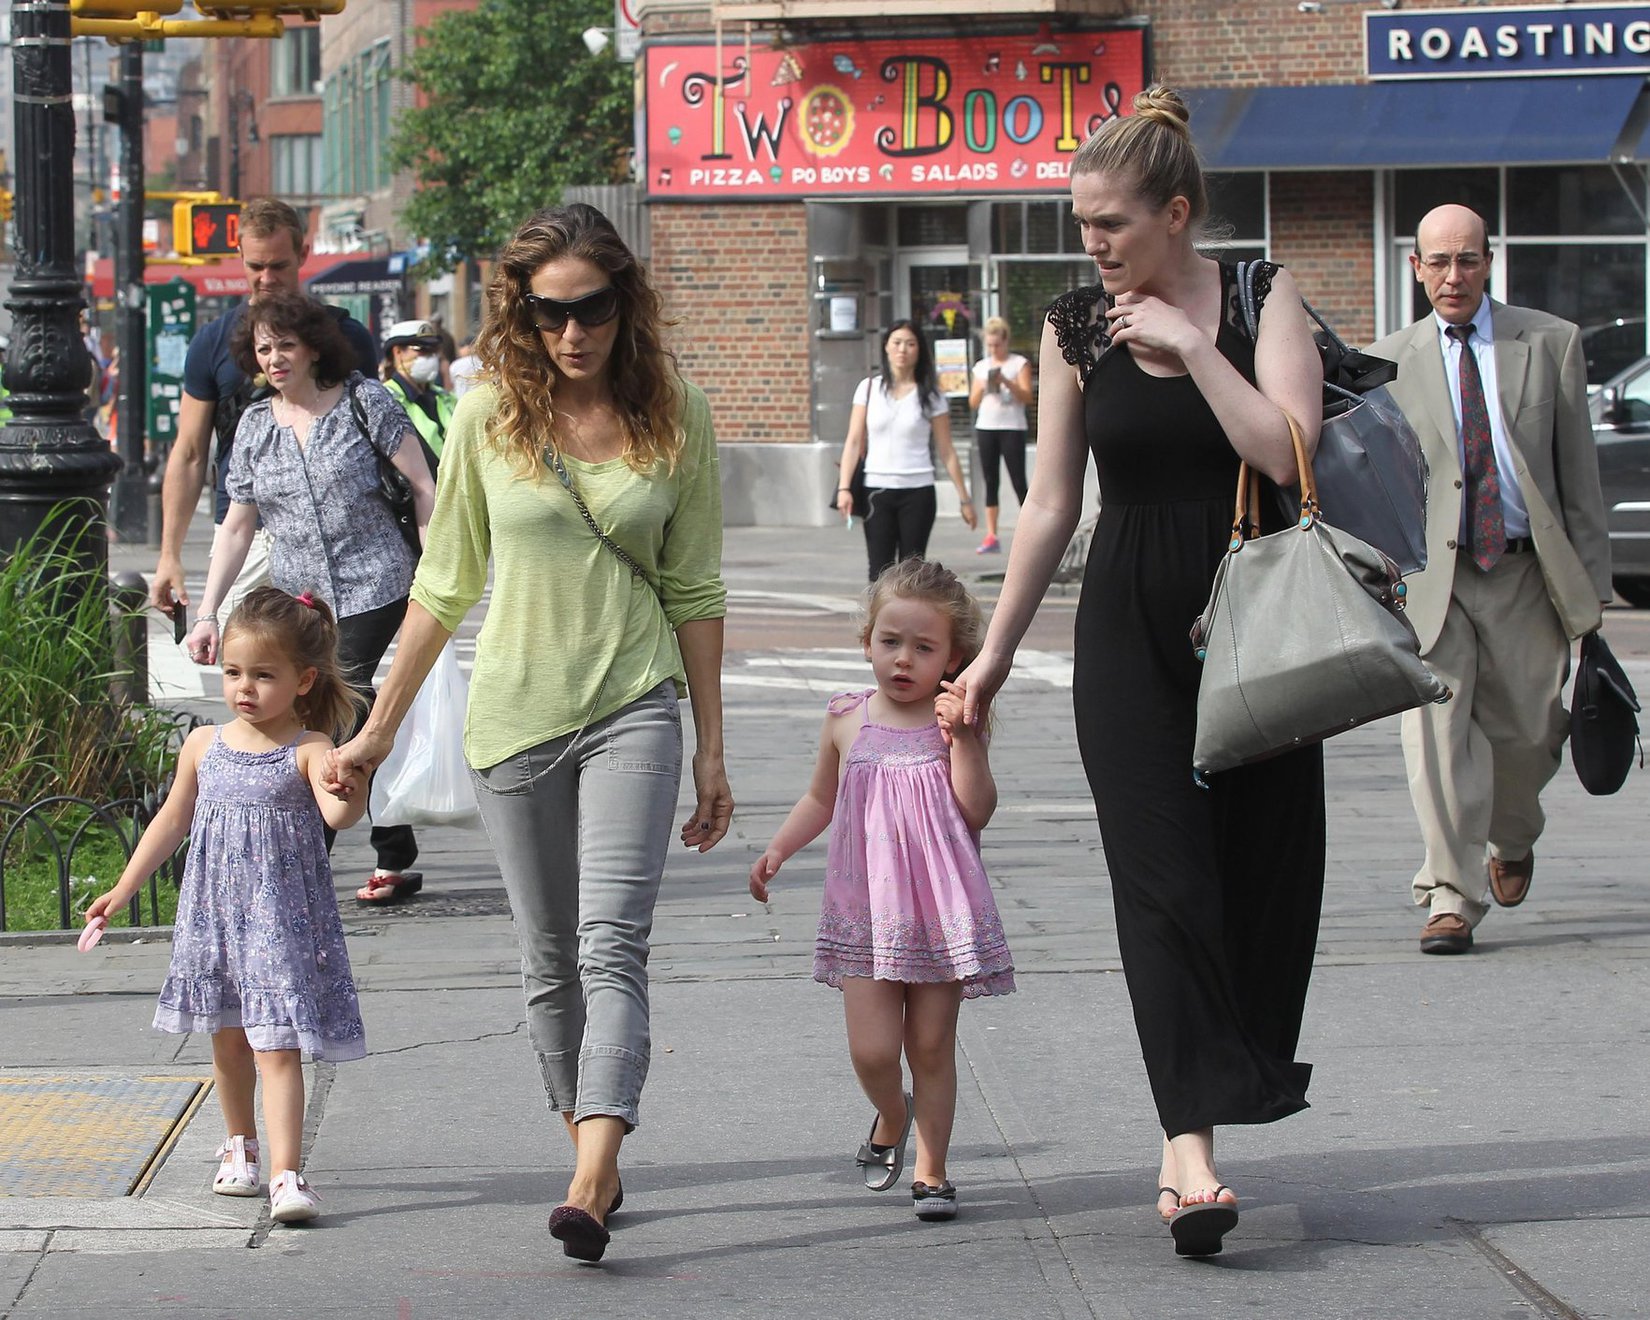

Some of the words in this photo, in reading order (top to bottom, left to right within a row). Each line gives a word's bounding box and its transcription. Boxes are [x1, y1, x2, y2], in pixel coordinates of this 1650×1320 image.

[1388, 20, 1650, 60] ROASTING
[689, 168, 764, 186] PIZZA
[820, 166, 871, 184] BOYS
[911, 162, 998, 182] SALADS
